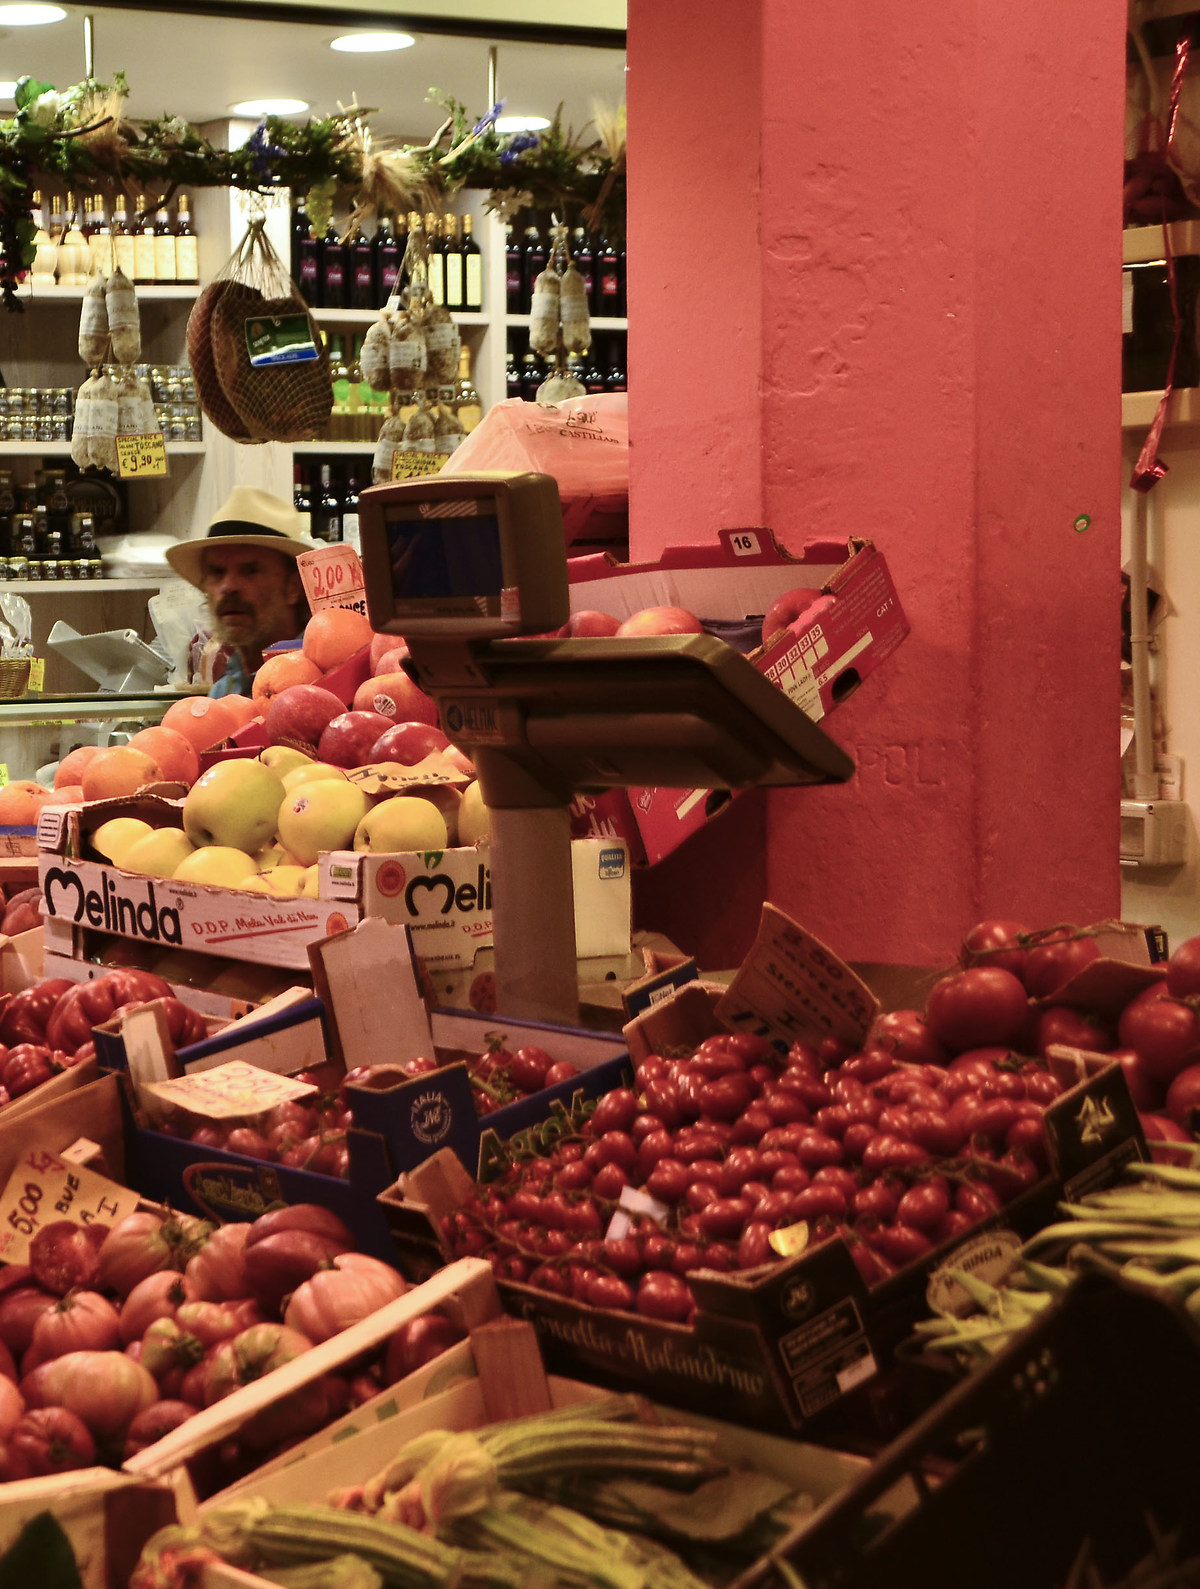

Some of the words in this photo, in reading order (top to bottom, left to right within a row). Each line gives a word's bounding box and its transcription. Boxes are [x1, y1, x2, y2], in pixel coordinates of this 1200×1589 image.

[734, 536, 752, 550] 16
[776, 658, 787, 673] 30
[788, 648, 799, 661] 32
[799, 637, 810, 650] 33
[810, 626, 821, 639] 35
[44, 867, 182, 945] Melinda
[404, 863, 492, 917] Meli
[54, 1173, 81, 1215] BUE
